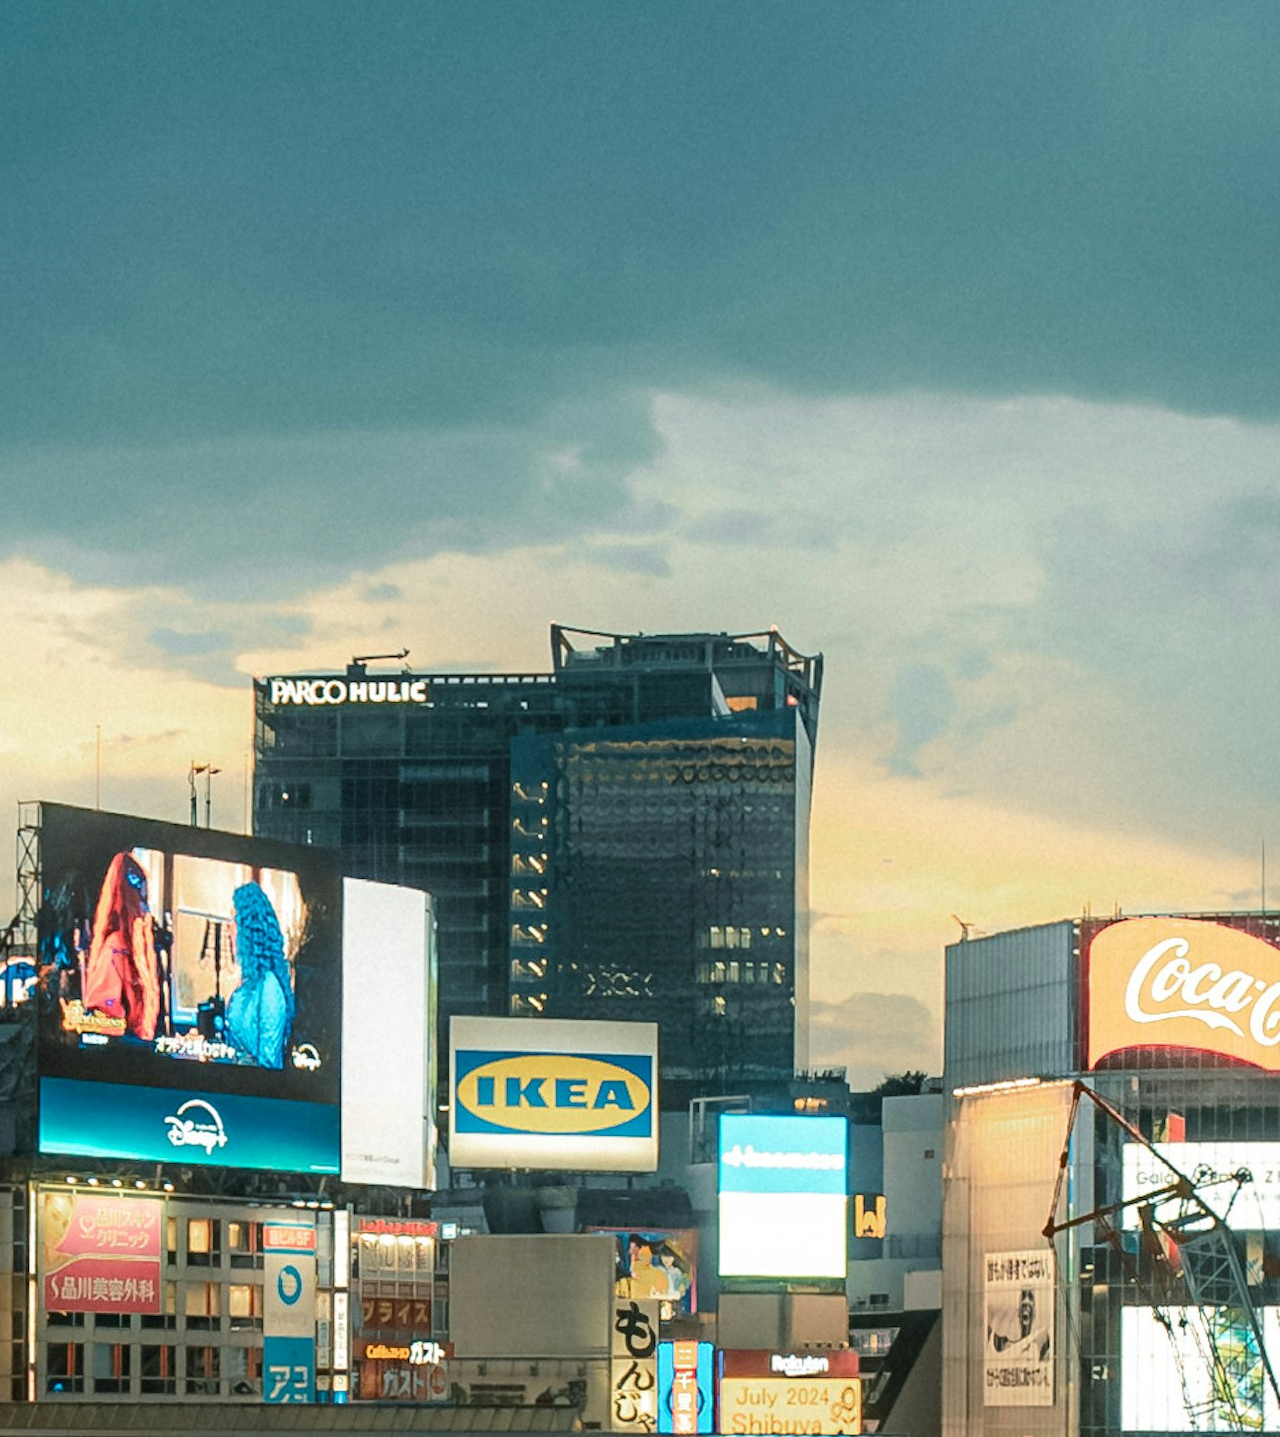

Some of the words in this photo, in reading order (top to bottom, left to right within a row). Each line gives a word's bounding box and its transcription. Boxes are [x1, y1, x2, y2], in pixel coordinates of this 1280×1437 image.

[270, 679, 347, 705] PARCO
[349, 681, 427, 703] HULIC
[476, 1076, 636, 1110] IKEA
[96, 1208, 156, 1229] 品川スキン
[96, 1229, 150, 1249] クリニック
[61, 1276, 155, 1303] 品川美容外科
[410, 1341, 446, 1365] ガスト
[771, 1354, 829, 1374] Rakuten
[615, 1301, 656, 1434] もんじゃ
[736, 1386, 778, 1408] July
[786, 1387, 829, 1406] 2024
